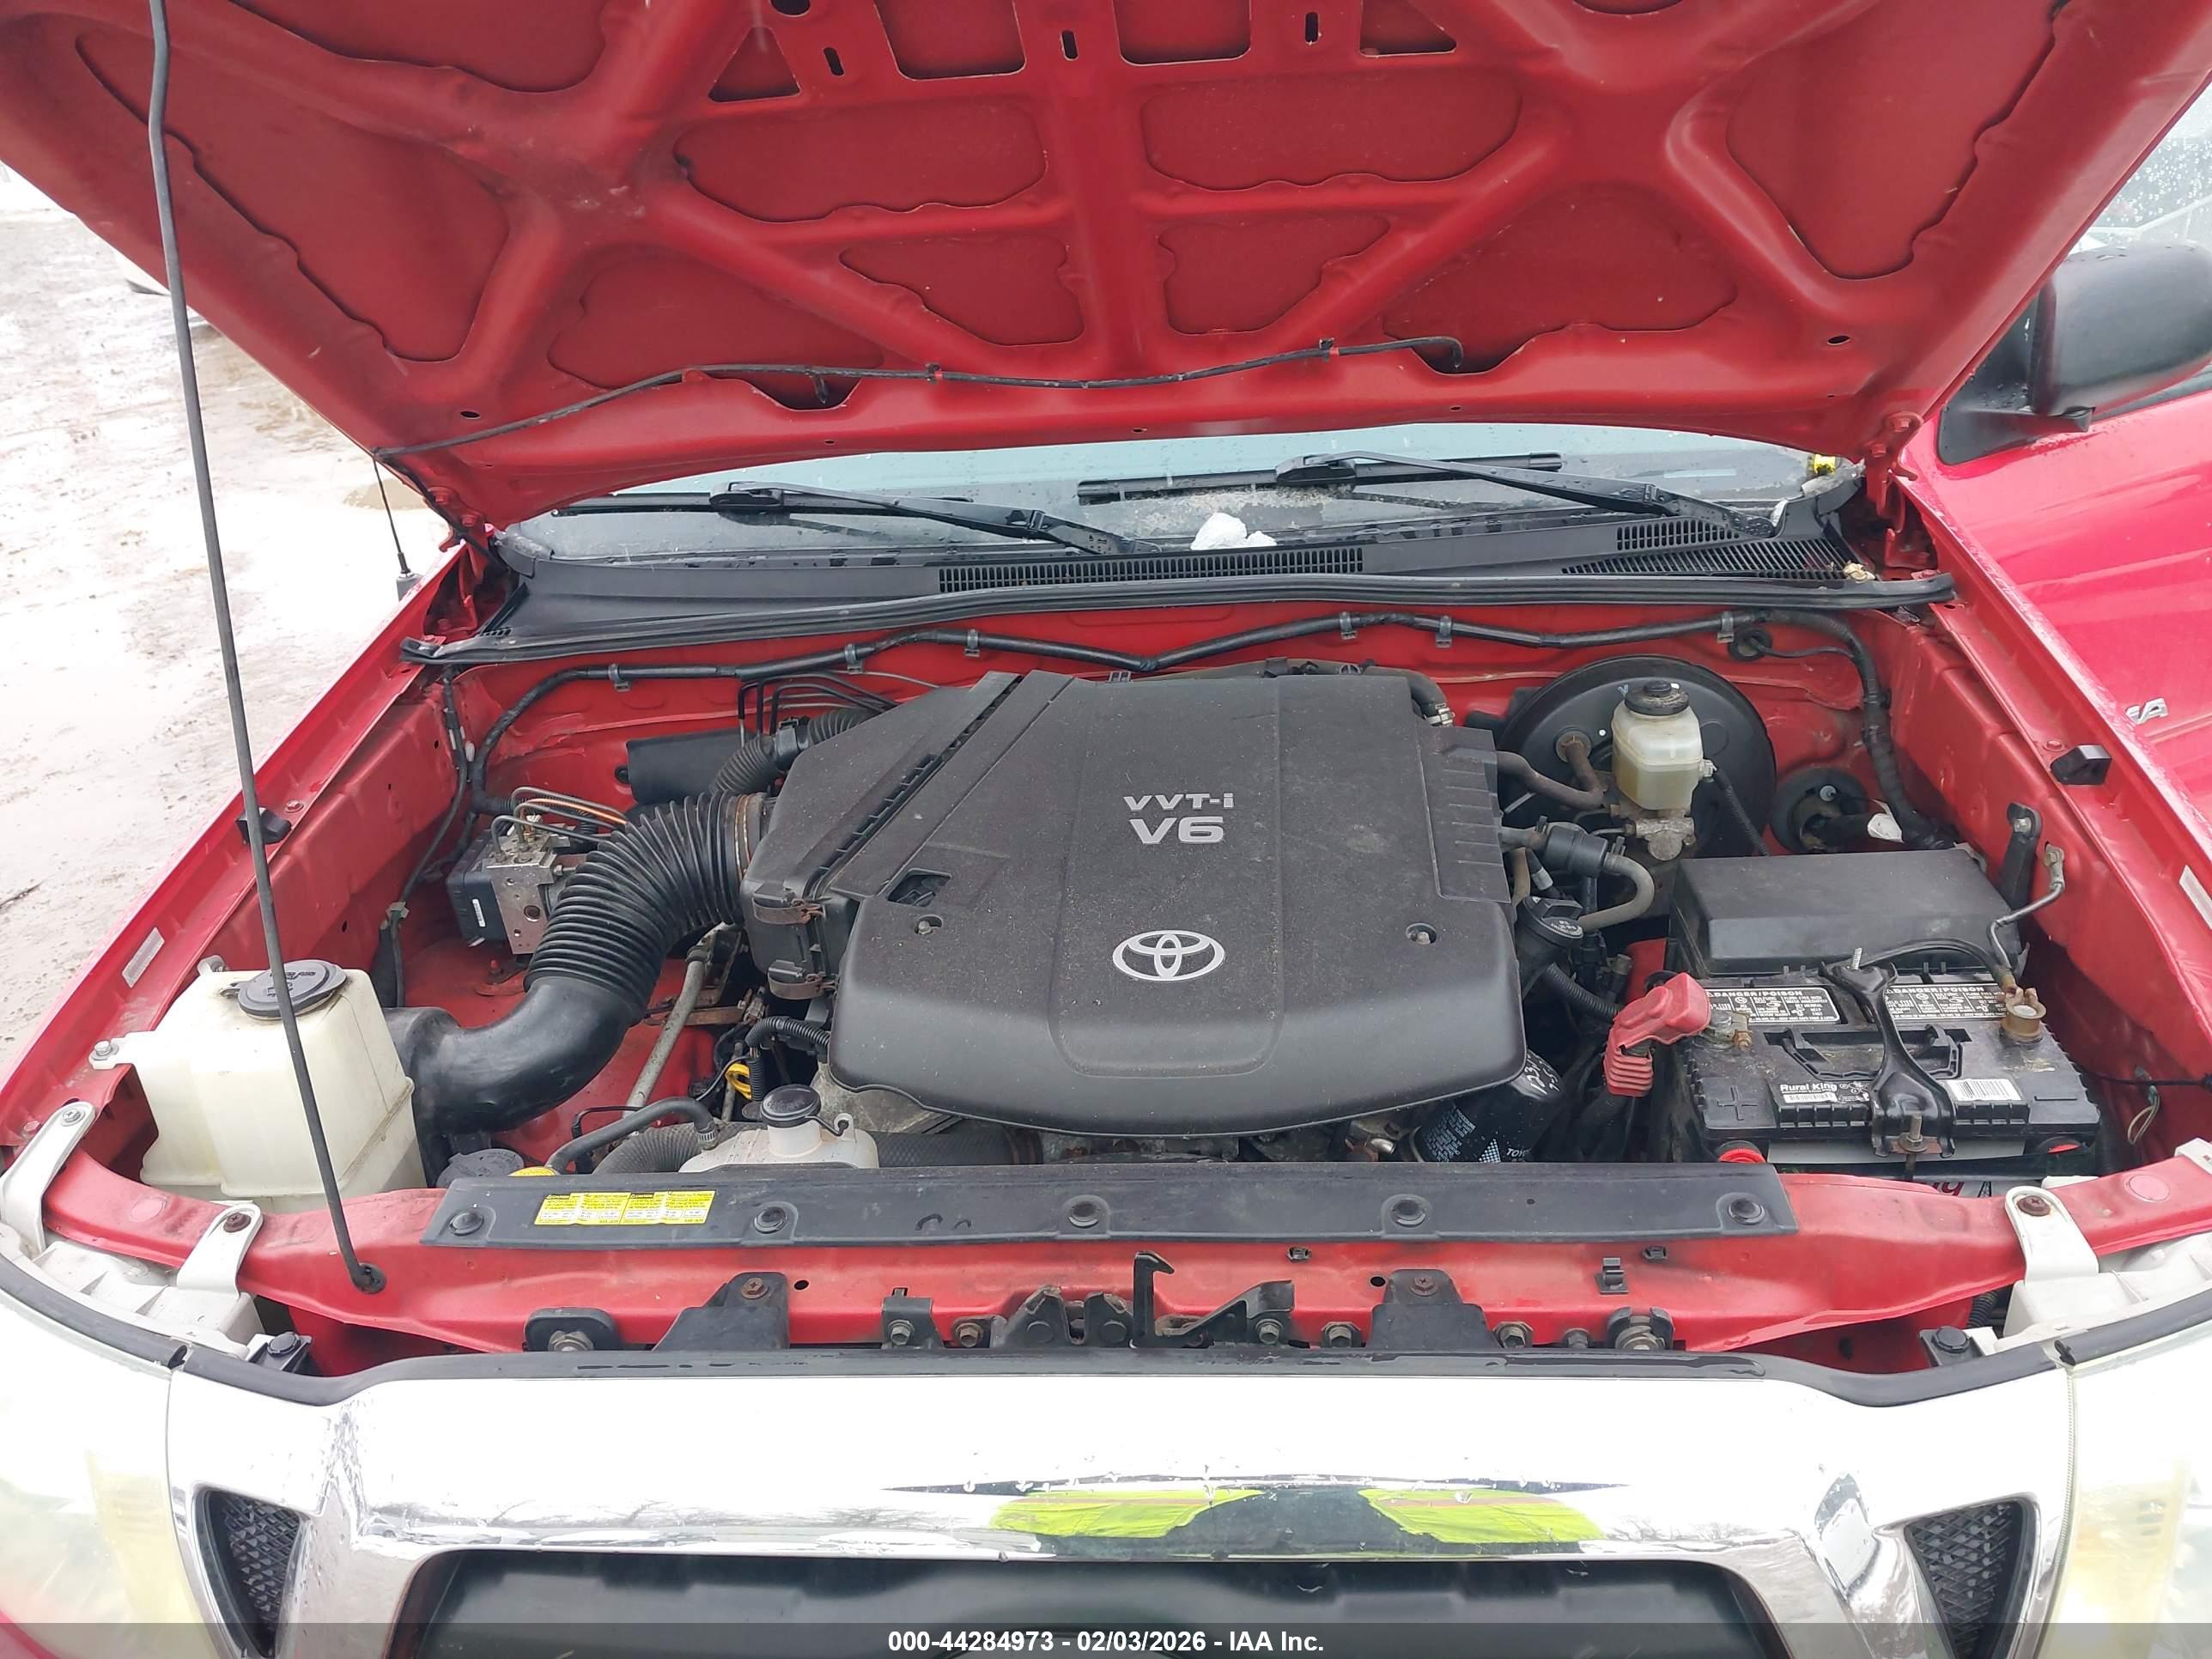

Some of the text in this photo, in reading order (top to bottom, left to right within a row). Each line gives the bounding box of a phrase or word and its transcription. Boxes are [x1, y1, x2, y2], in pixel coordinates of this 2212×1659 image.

[1123, 793, 1234, 811] VVT-i
[1129, 816, 1224, 845] V6
[1812, 1083, 1838, 1091] King
